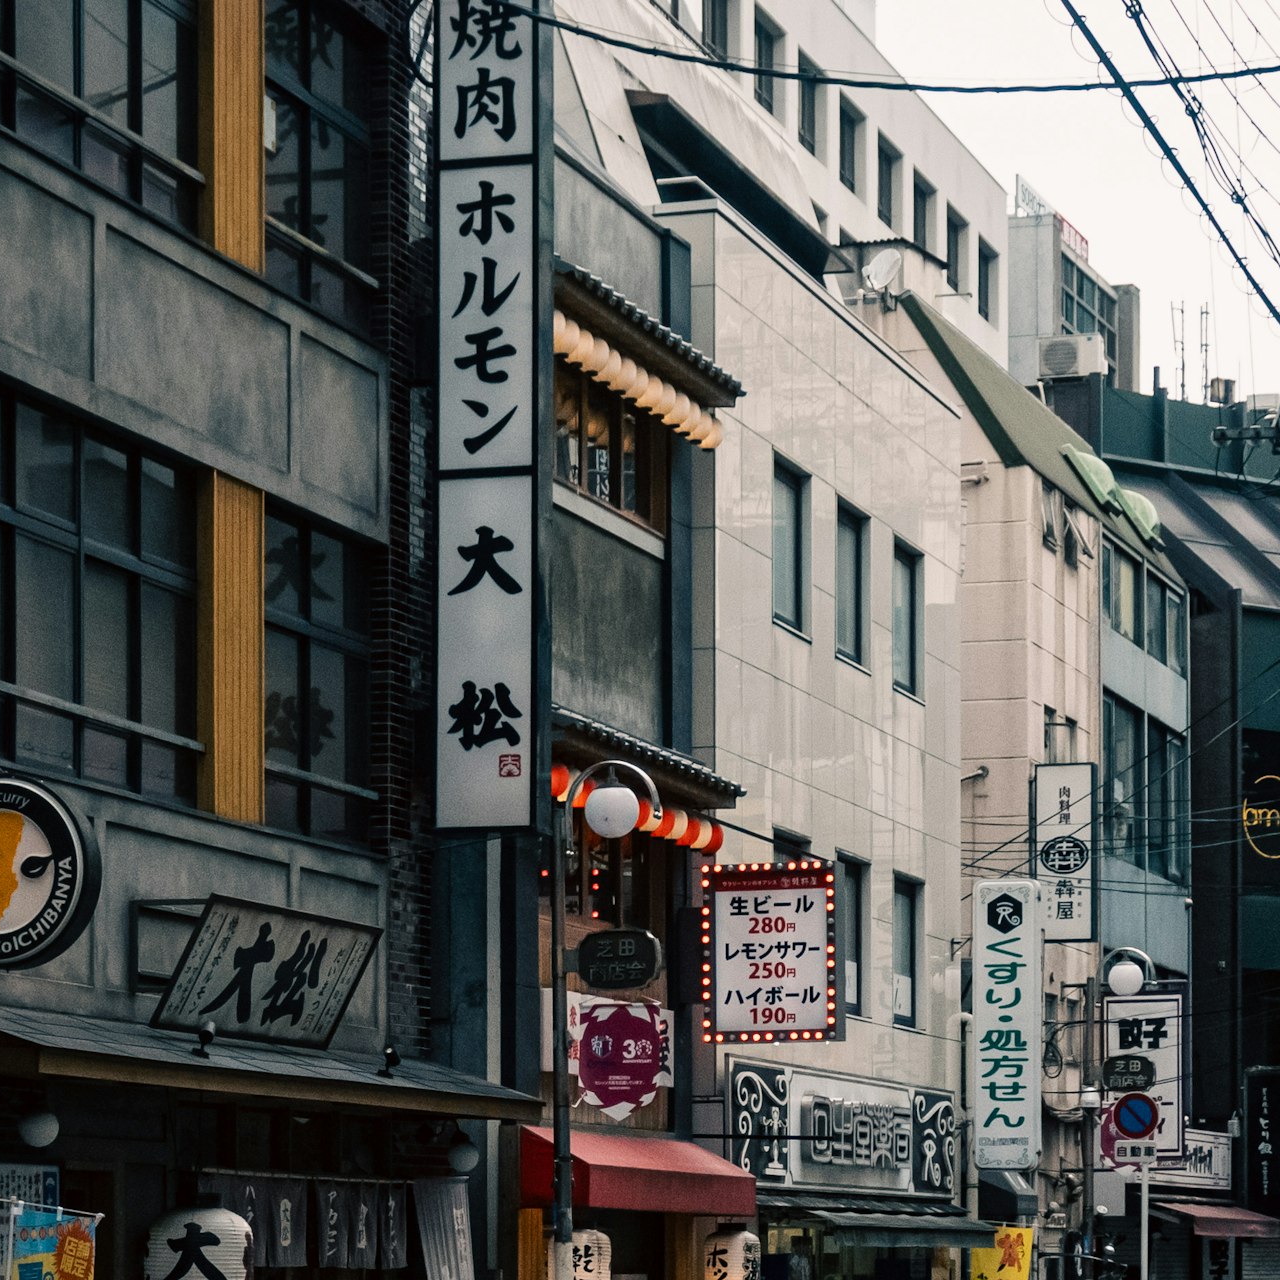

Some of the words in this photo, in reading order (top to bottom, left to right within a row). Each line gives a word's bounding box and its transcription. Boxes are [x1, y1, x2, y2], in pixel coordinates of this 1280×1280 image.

[449, 0, 523, 141] 焼肉
[451, 180, 520, 455] ホルモン
[447, 526, 523, 751] 大松
[1059, 786, 1071, 824] 肉料理
[730, 895, 814, 916] 生ビール
[748, 916, 796, 934] 280円
[597, 939, 635, 957] 芝田
[725, 940, 821, 961] レモンサワー
[198, 921, 329, 1027] 大松
[748, 961, 796, 980] 250円
[724, 985, 820, 1006] ハイボール
[749, 1007, 796, 1025] 190円
[979, 936, 1029, 1129] くすり・処方せん
[1114, 1061, 1141, 1072] 芝田
[1117, 1147, 1155, 1157] 自動車
